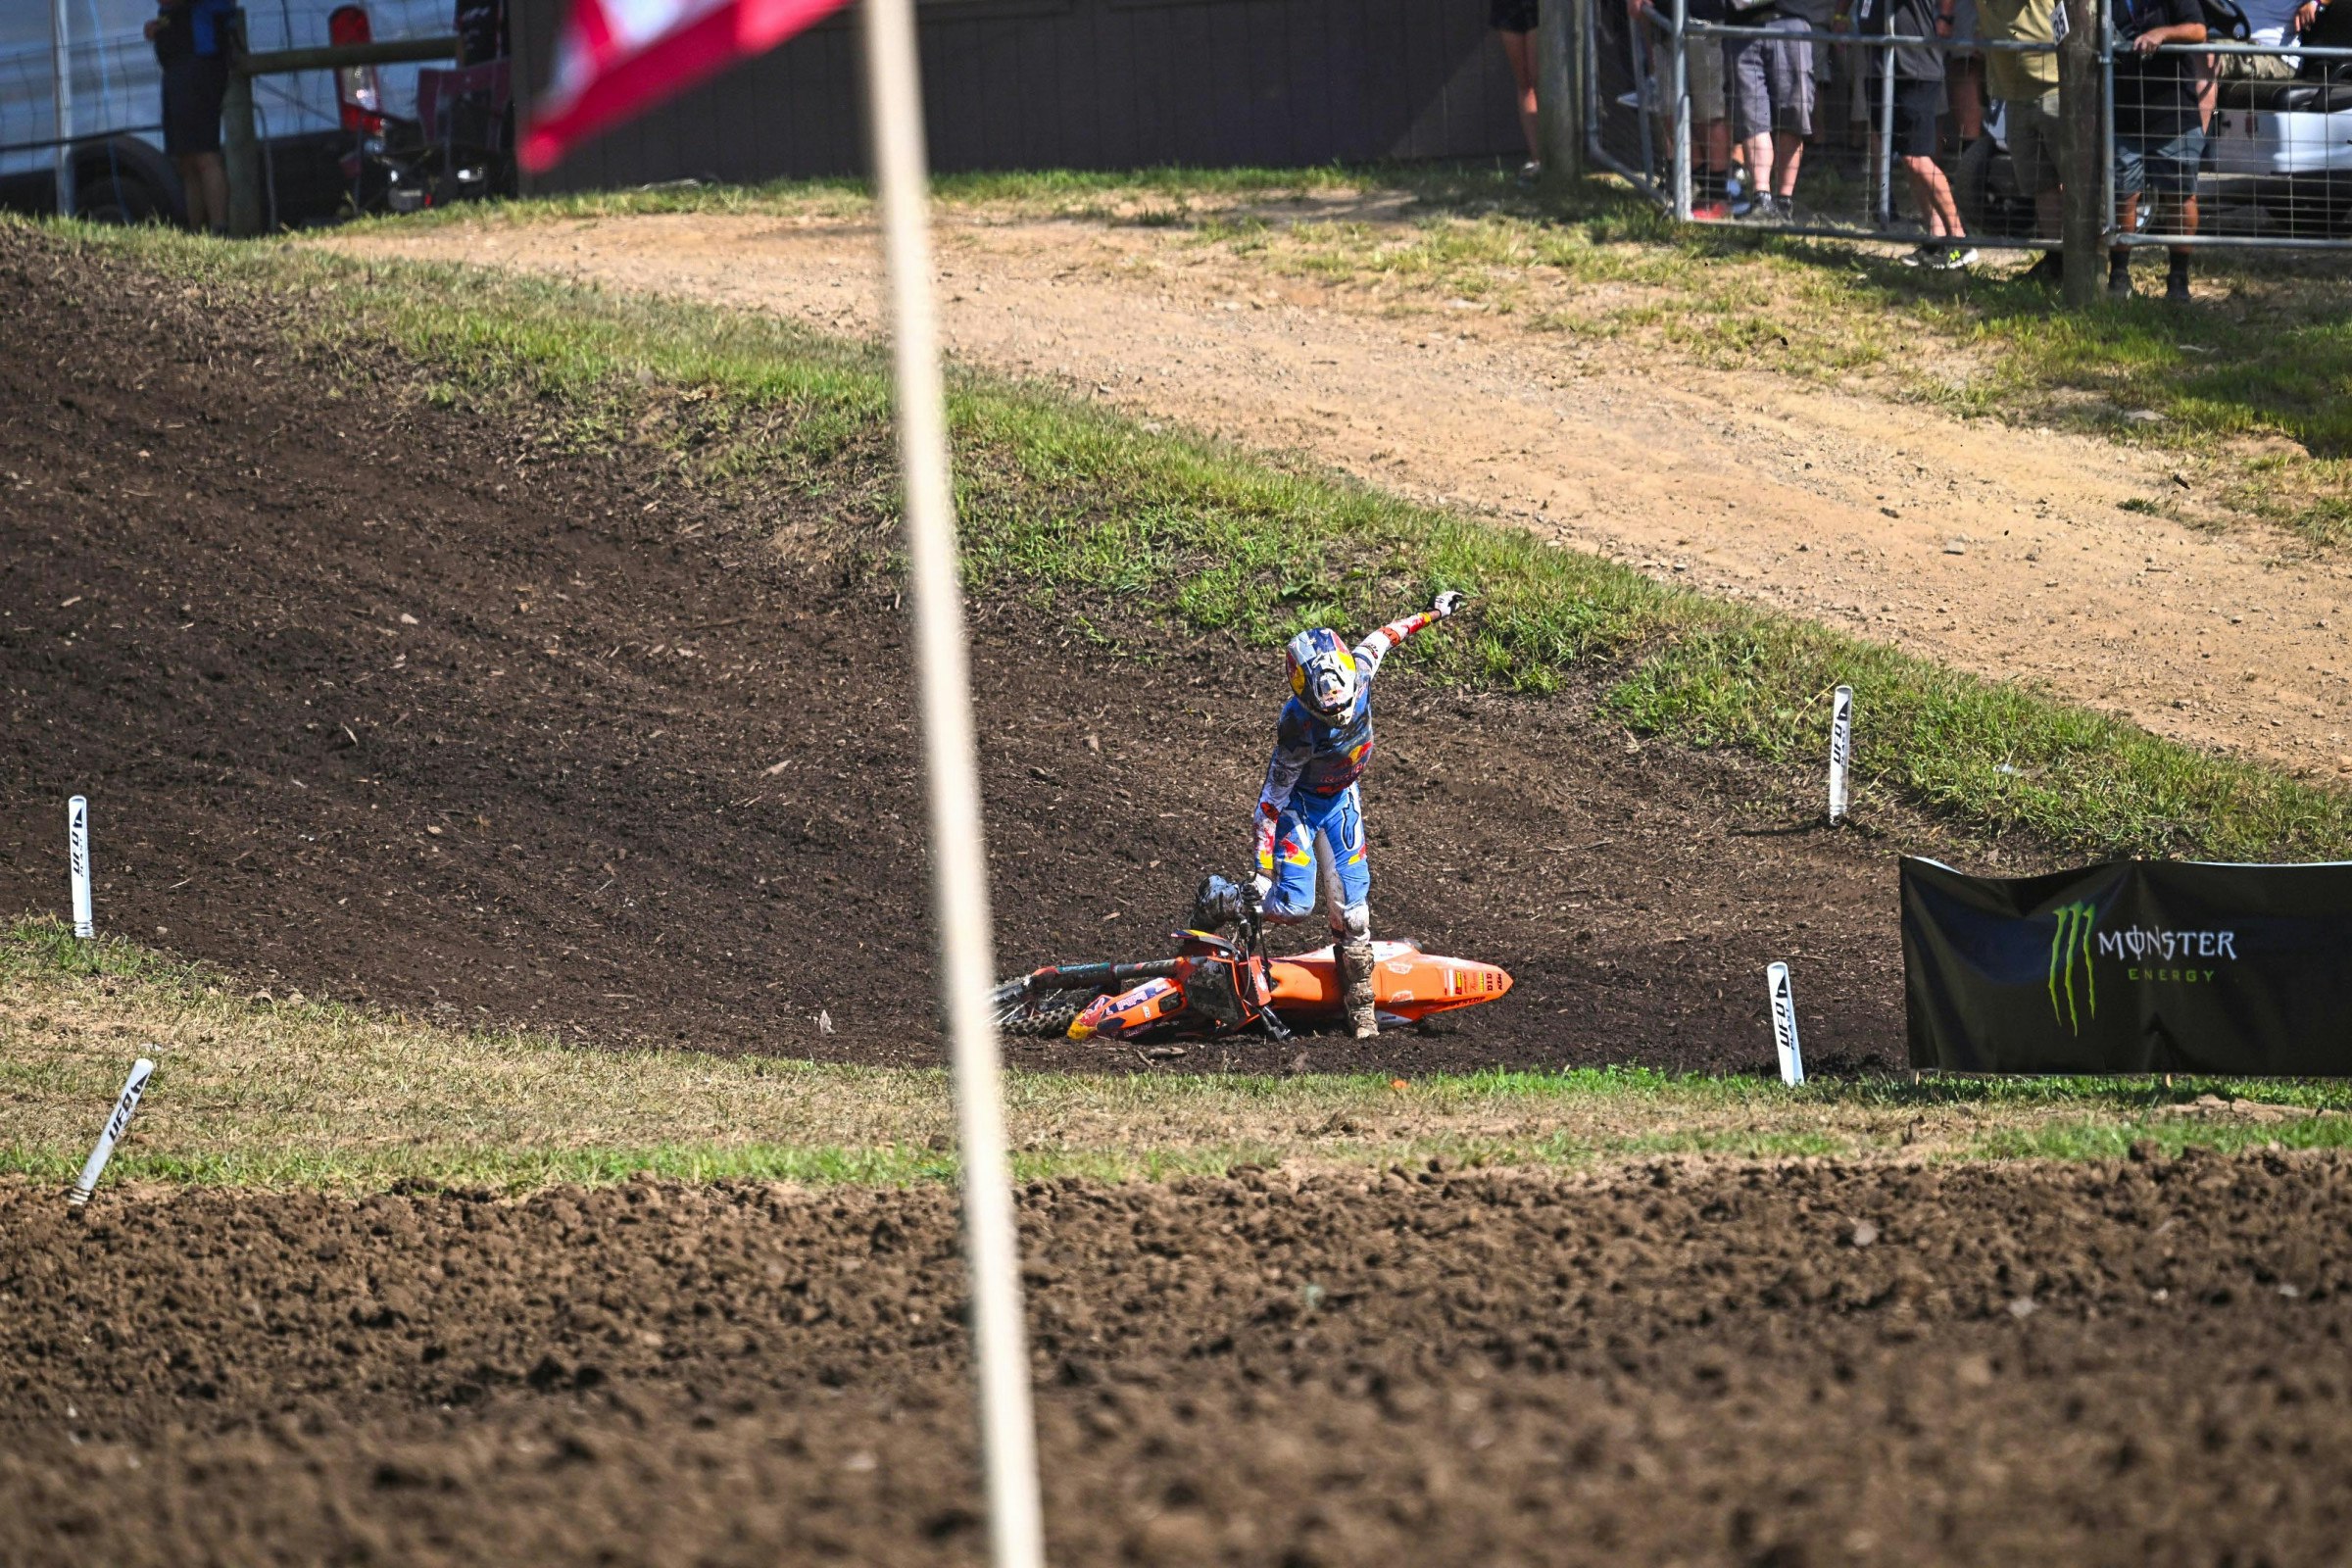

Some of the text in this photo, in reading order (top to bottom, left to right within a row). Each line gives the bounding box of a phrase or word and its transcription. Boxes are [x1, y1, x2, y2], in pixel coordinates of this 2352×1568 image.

[2053, 12, 2066, 42] 35
[1833, 722, 1842, 765] UFO
[72, 830, 80, 876] UFO
[2098, 925, 2237, 961] MONSTER
[2128, 968, 2215, 982] ENERGY
[1775, 1002, 1790, 1049] UFO
[108, 1092, 133, 1142] UFO
